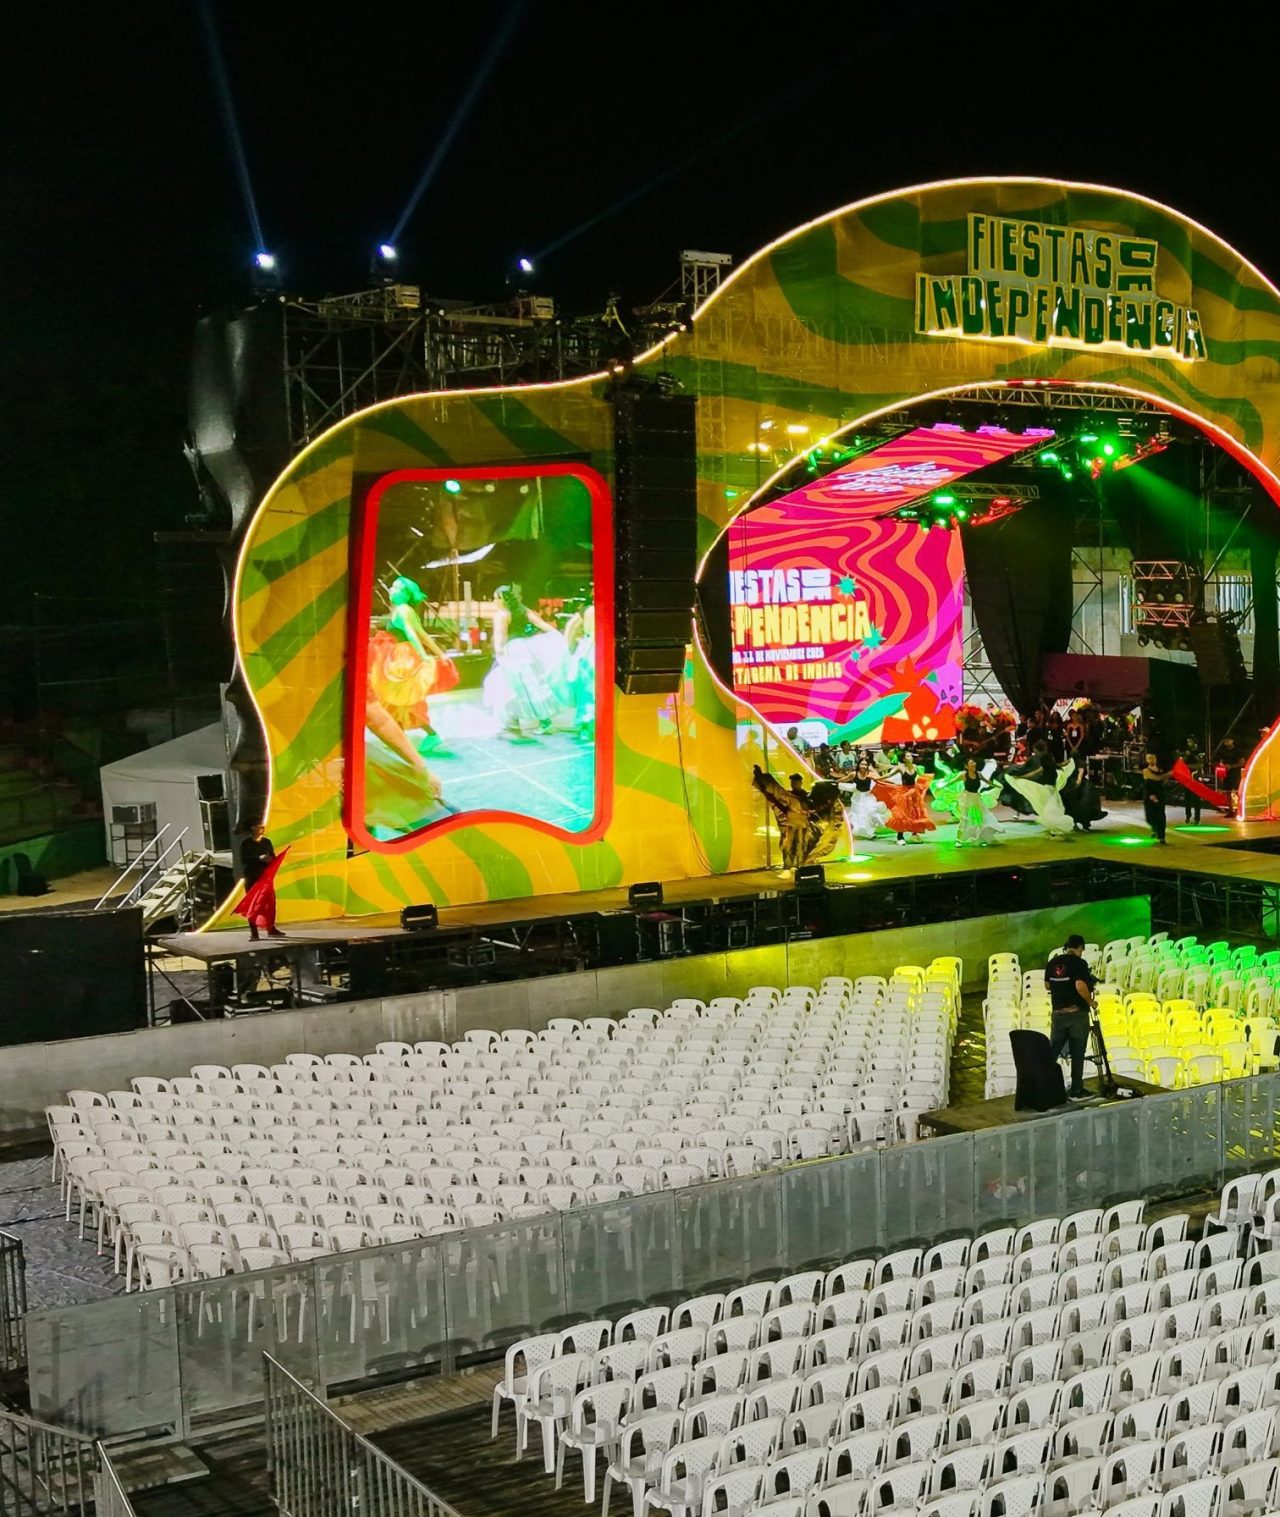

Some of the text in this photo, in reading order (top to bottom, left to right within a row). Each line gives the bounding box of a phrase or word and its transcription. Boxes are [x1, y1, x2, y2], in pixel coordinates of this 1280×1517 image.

[971, 213, 1157, 292] FIESTAS DE
[917, 275, 1204, 359] INDEPENDENCIA
[730, 569, 832, 605] IESTAS DE
[731, 601, 872, 648] PENDENCIA
[733, 661, 842, 685] TAGENA DE INDIAS
[765, 647, 805, 662] NOVIEMBRE
